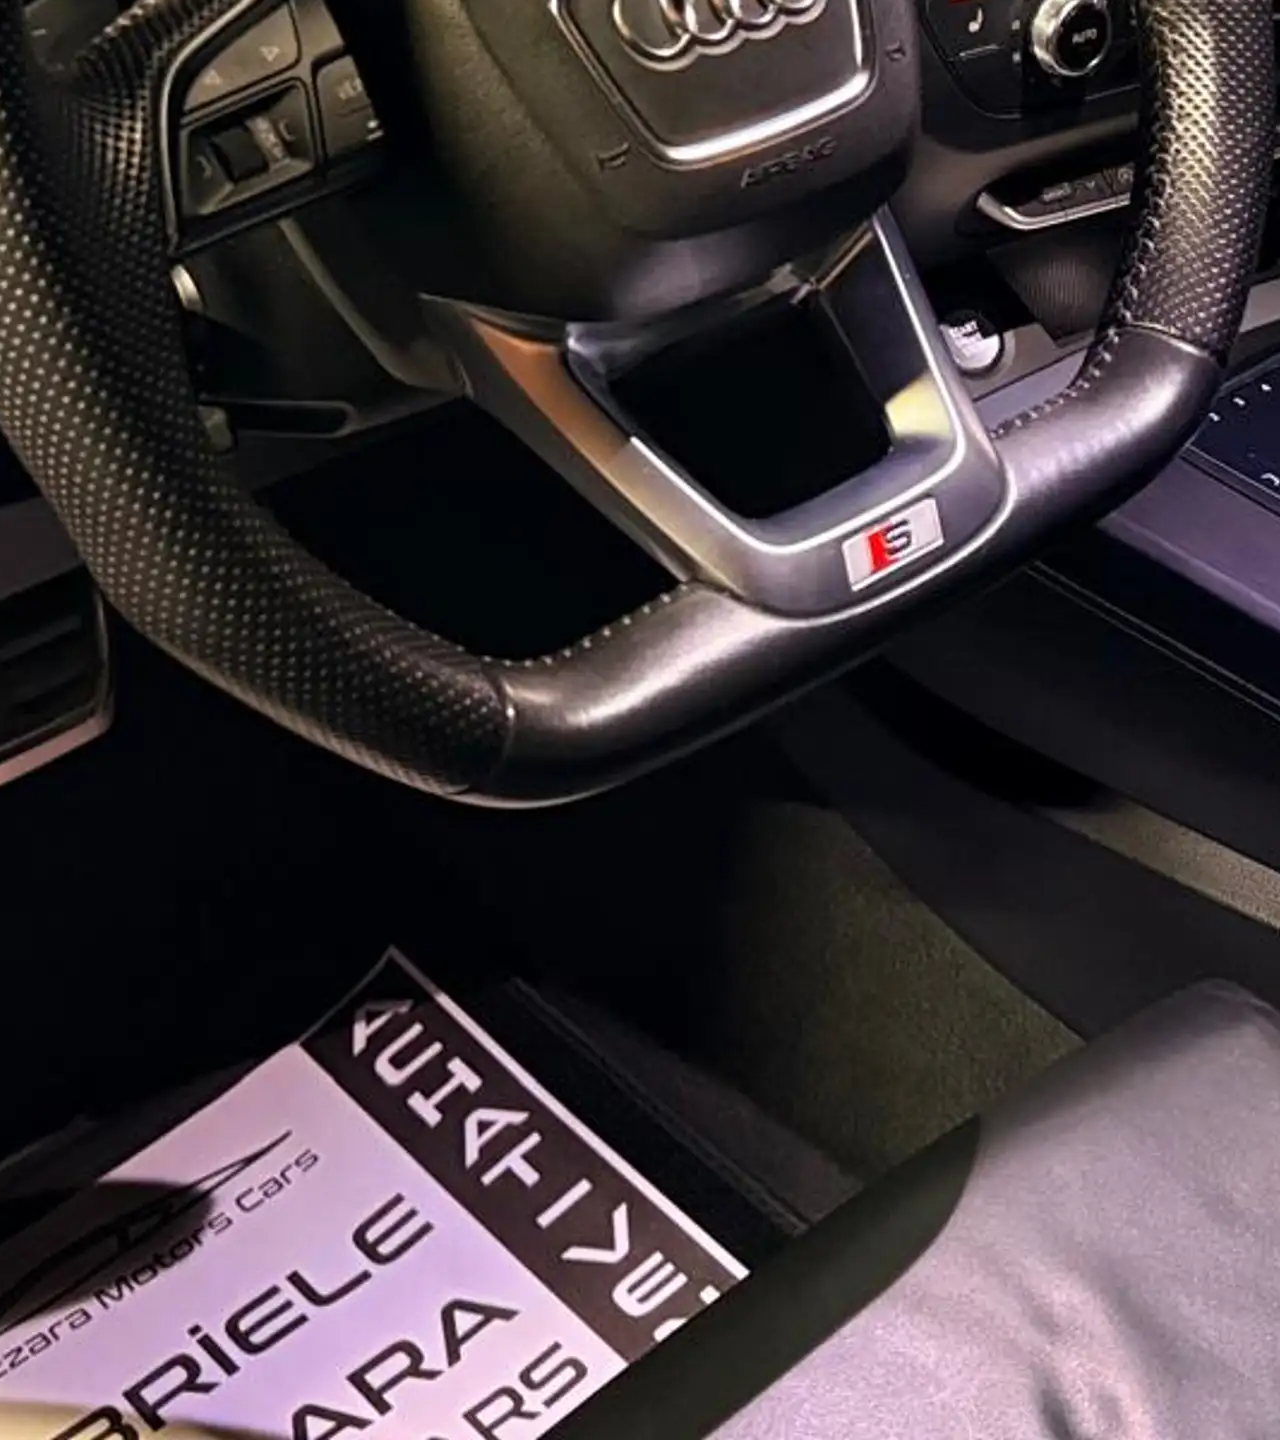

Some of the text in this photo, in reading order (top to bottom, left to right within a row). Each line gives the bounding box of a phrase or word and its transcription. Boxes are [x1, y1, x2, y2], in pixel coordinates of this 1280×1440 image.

[94, 1212, 233, 1310] Motors
[235, 1147, 320, 1214] Cars
[427, 1340, 589, 1440] RS
